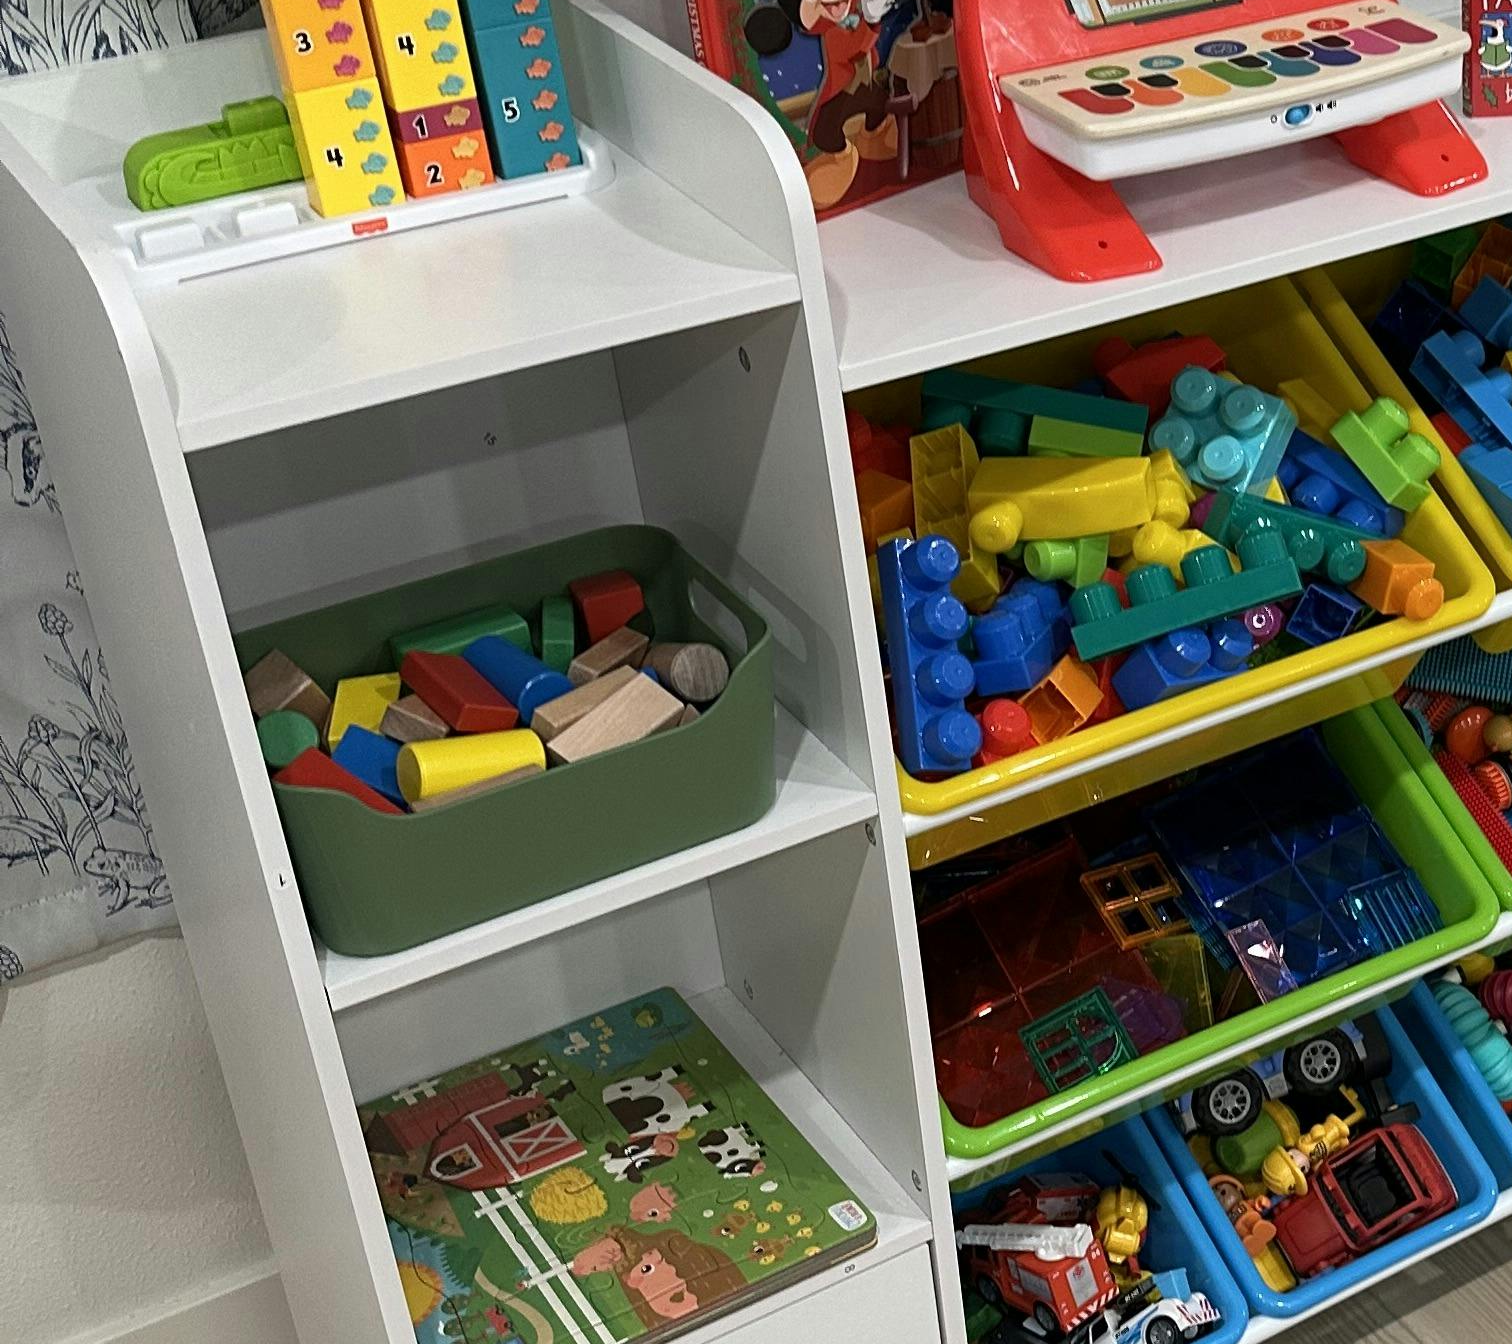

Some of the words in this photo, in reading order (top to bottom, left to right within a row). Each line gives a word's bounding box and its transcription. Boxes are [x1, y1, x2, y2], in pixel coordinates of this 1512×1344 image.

[295, 32, 312, 52] 3
[398, 35, 414, 56] 4
[503, 100, 518, 120] 5
[414, 116, 427, 137] 1
[326, 148, 343, 167] 4
[426, 164, 443, 184] 2
